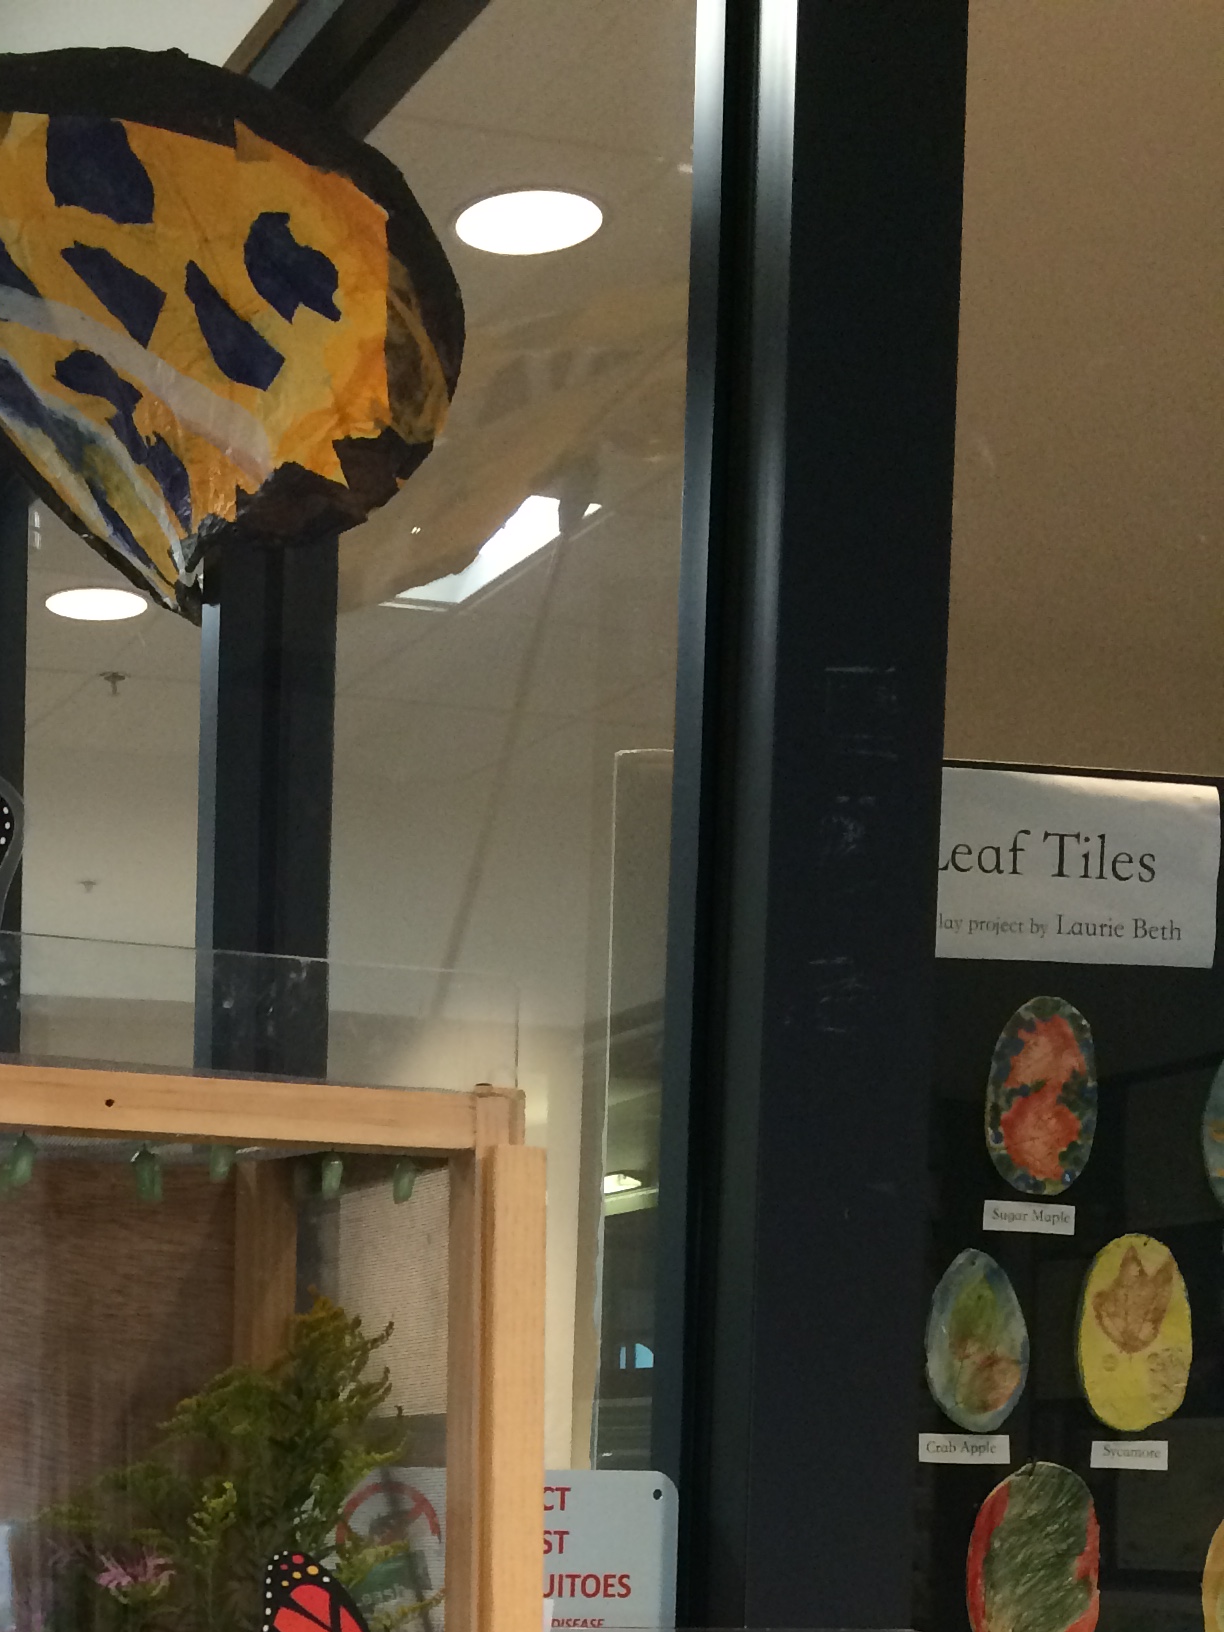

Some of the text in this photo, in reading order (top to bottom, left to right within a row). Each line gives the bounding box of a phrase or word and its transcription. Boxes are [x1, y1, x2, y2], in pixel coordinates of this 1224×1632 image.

[938, 830, 1155, 882] eaf Tiles
[968, 914, 1181, 940] project by Laurie Beth
[991, 1208, 1071, 1226] Sugar Maple
[925, 1440, 996, 1456] Crab Apple
